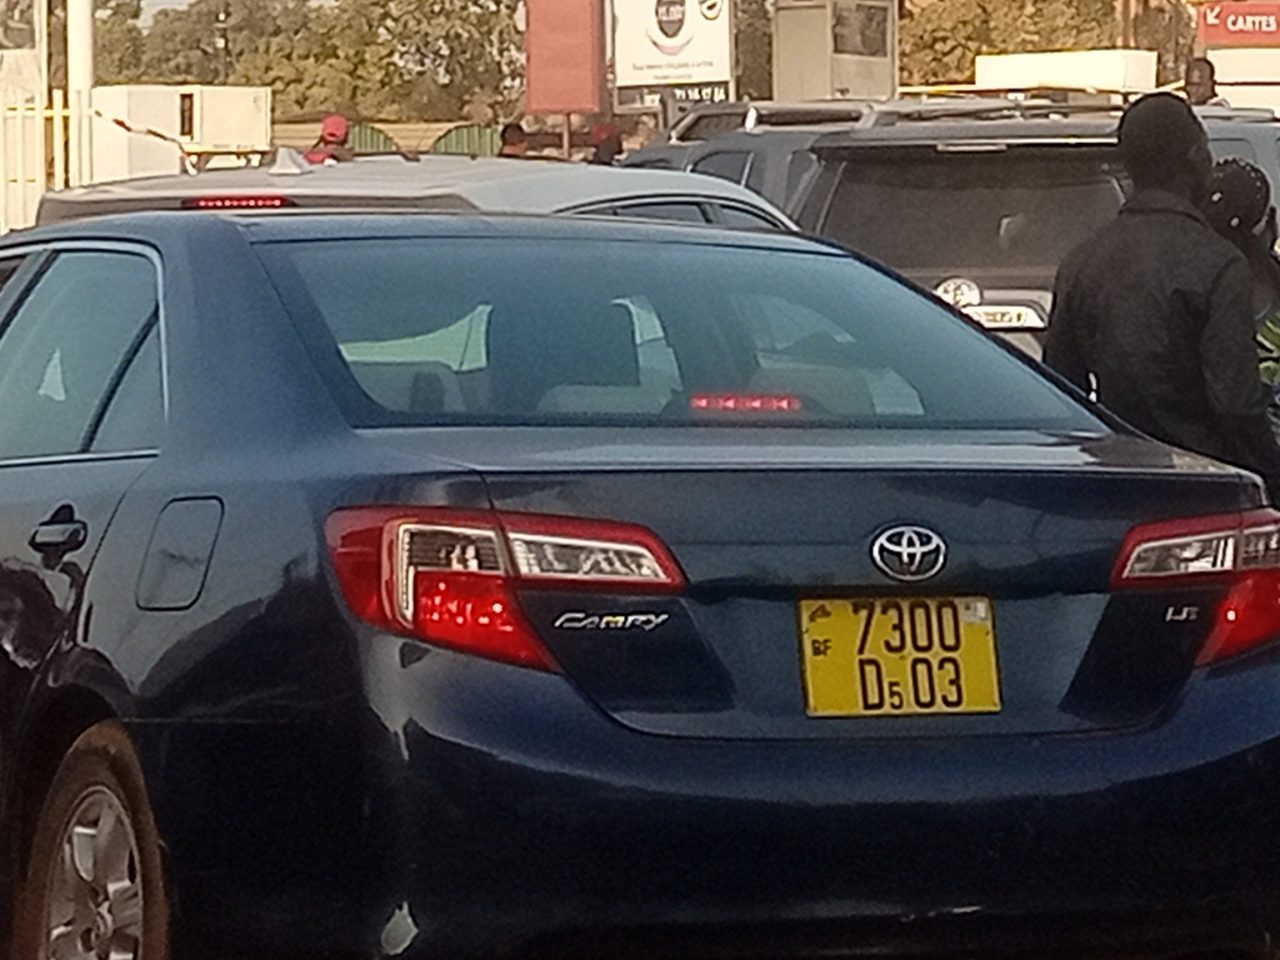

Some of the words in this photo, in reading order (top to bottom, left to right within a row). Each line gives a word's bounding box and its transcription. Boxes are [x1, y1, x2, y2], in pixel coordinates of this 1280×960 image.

[1227, 14, 1278, 32] CARTES
[852, 600, 962, 655] 7300
[812, 640, 832, 656] BF
[911, 656, 963, 709] 03
